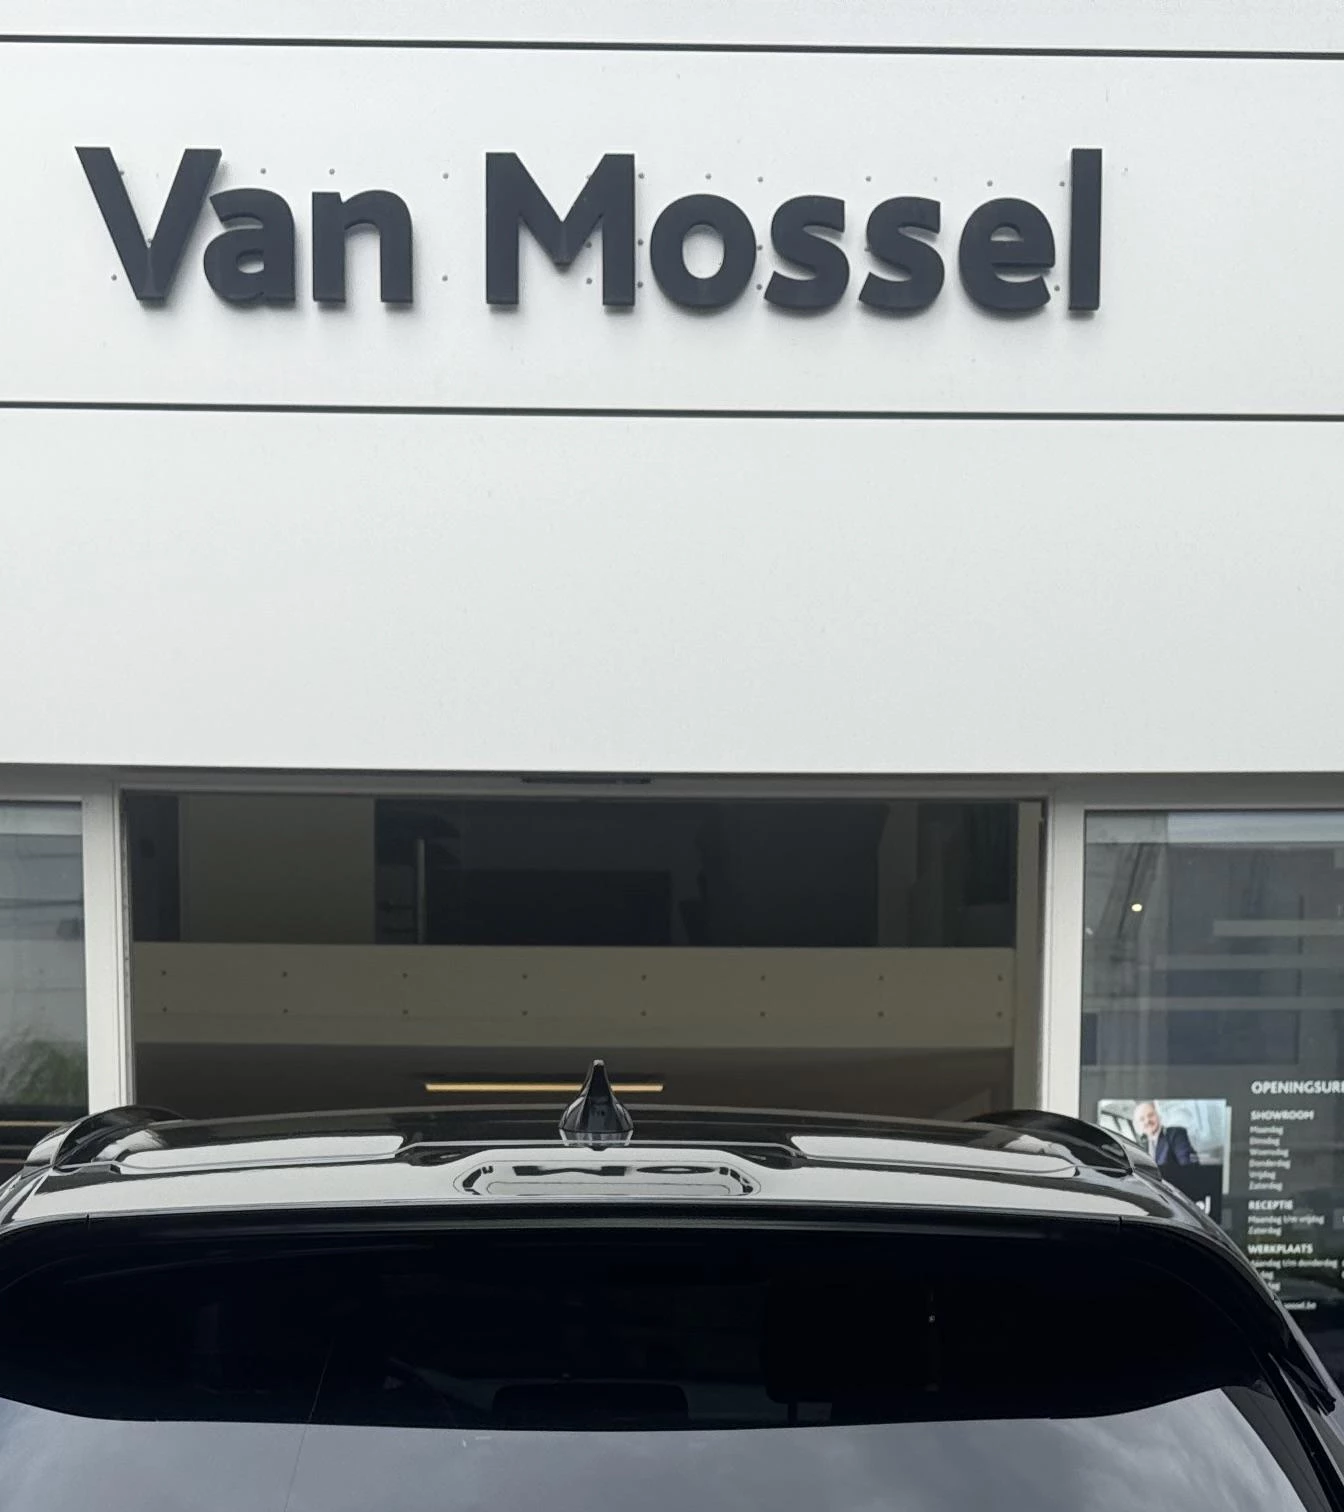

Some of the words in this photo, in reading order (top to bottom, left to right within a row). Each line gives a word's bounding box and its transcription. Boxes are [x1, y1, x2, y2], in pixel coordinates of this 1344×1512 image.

[74, 145, 415, 308] Van
[484, 147, 1104, 313] Mossel
[1250, 1110, 1314, 1121] SHOWROOM
[1248, 1200, 1293, 1210] RECEPTIE
[1248, 1243, 1313, 1254] WERKPLAATS
